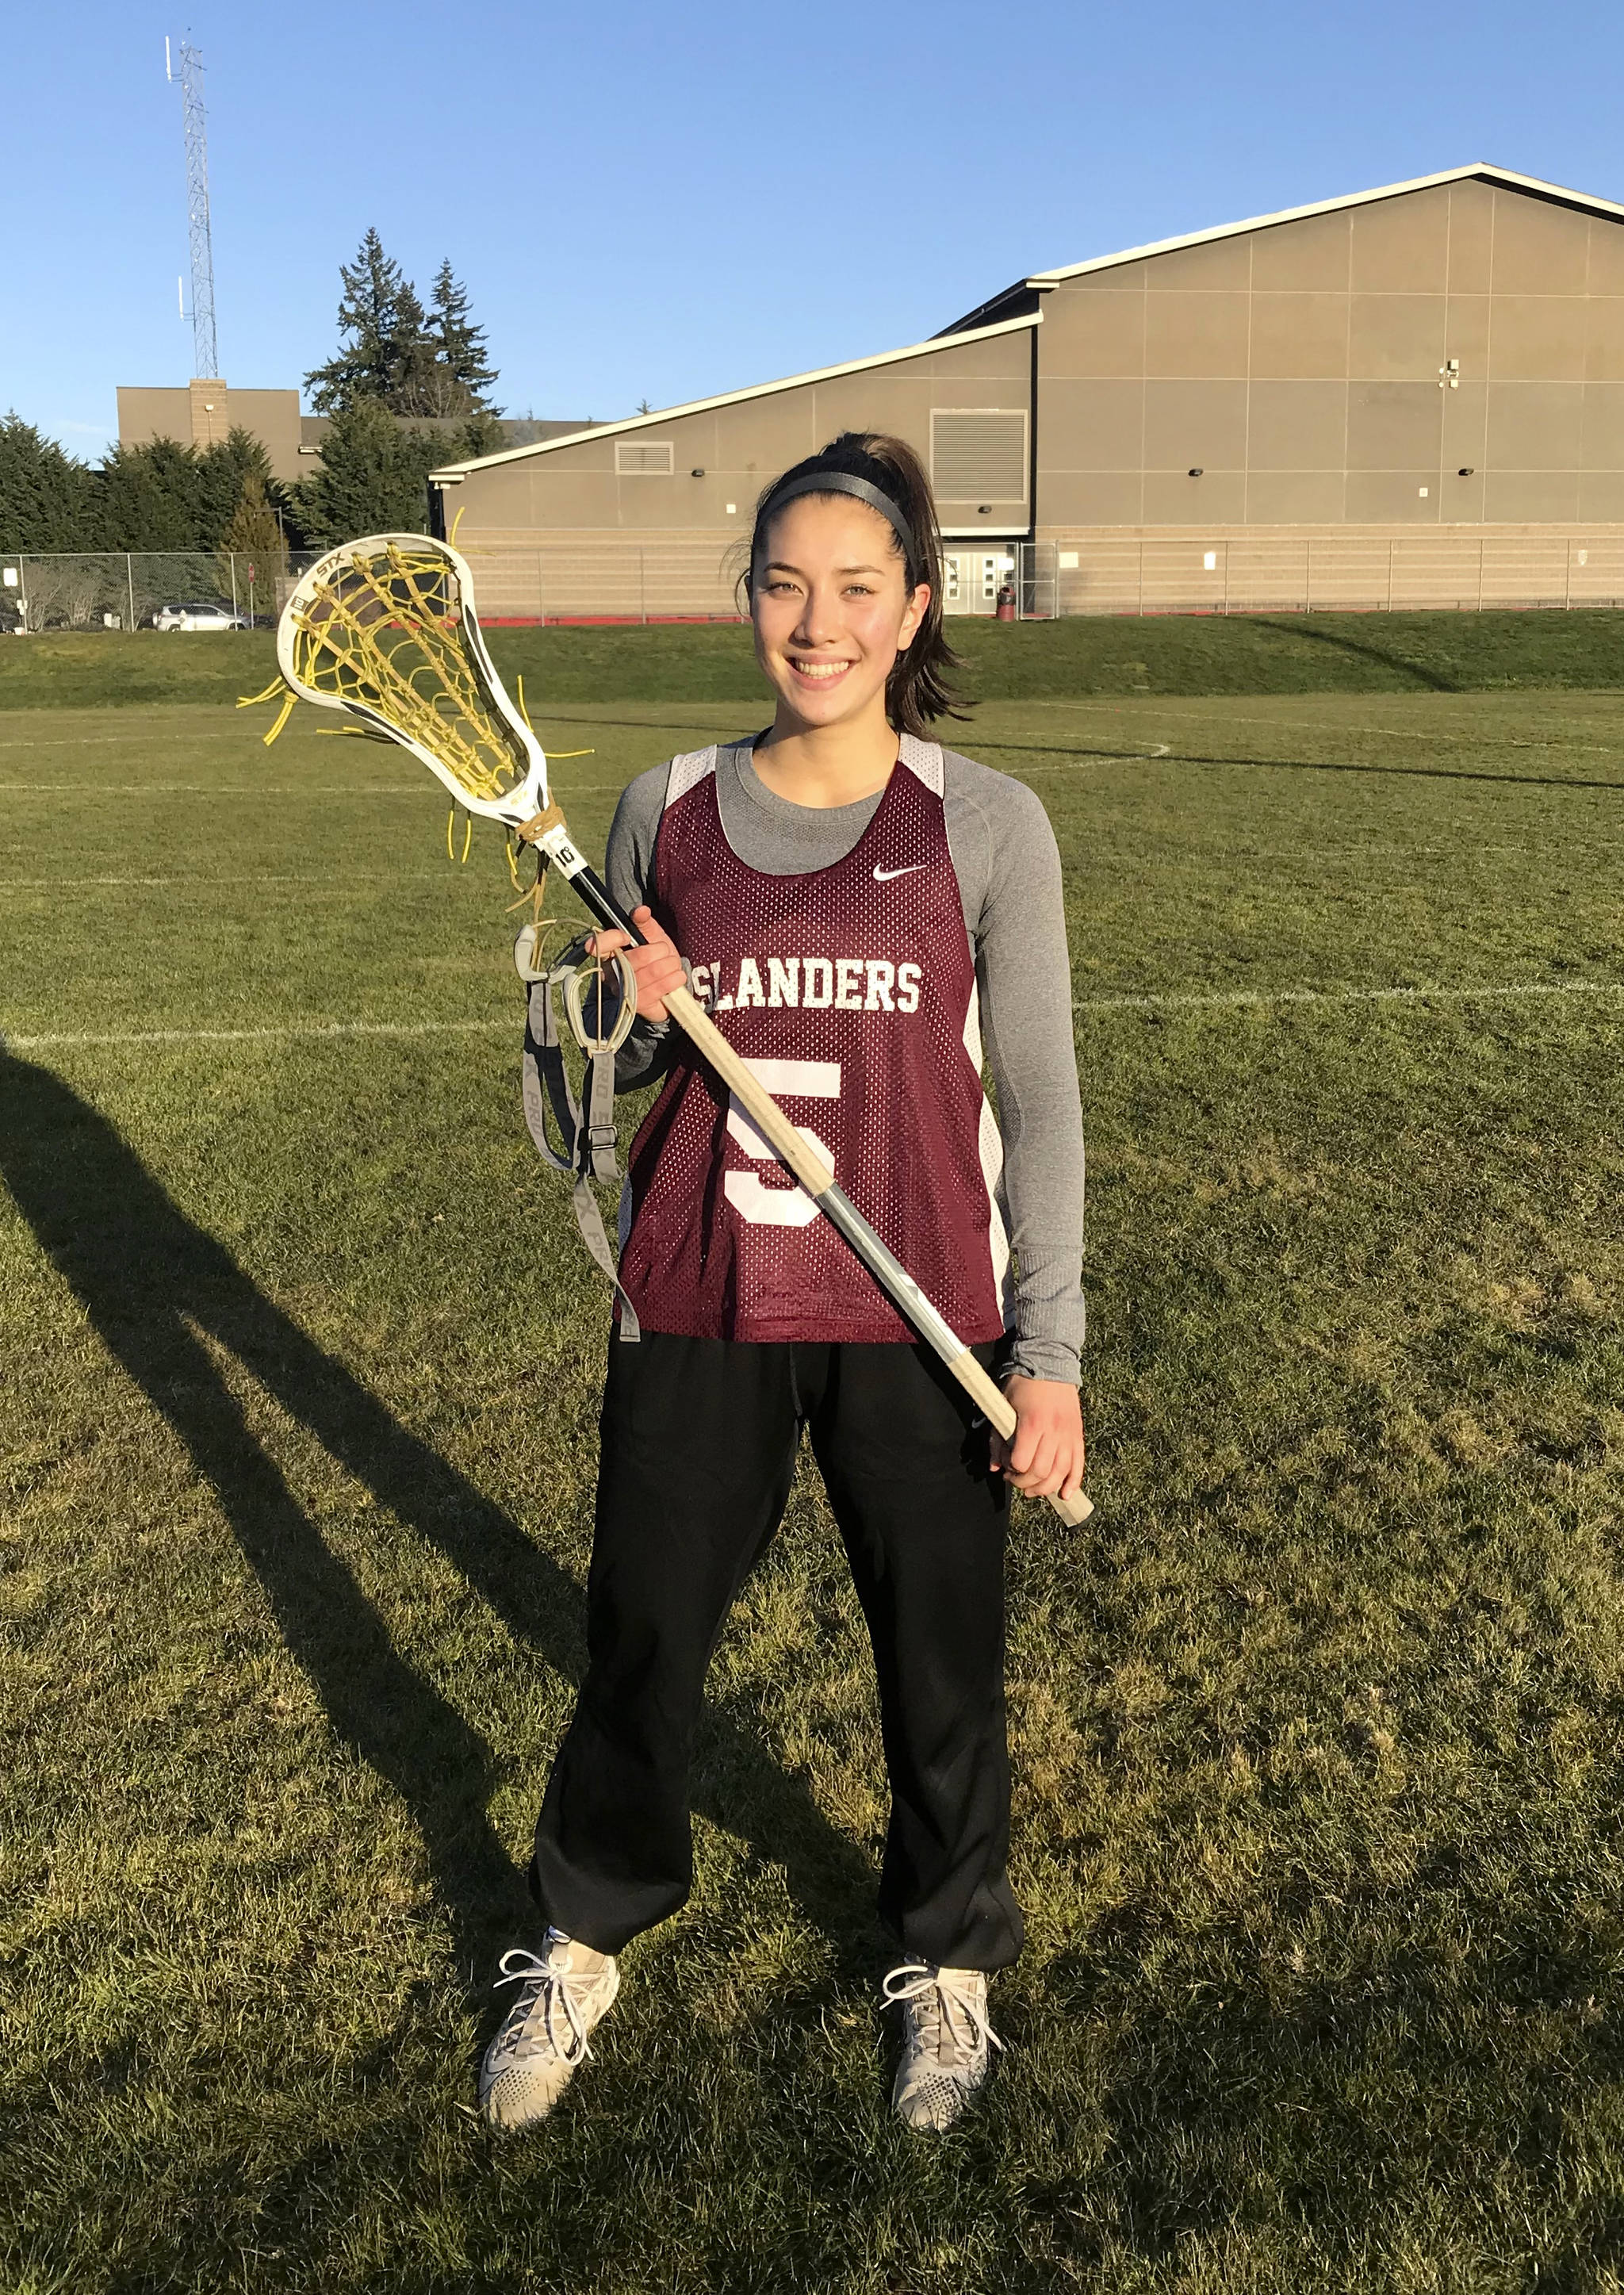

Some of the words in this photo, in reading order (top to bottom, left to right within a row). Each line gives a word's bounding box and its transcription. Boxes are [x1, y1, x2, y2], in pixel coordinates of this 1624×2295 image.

[316, 552, 345, 578] STX
[691, 956, 922, 1013] SLANDERS
[724, 1057, 841, 1228] 5
